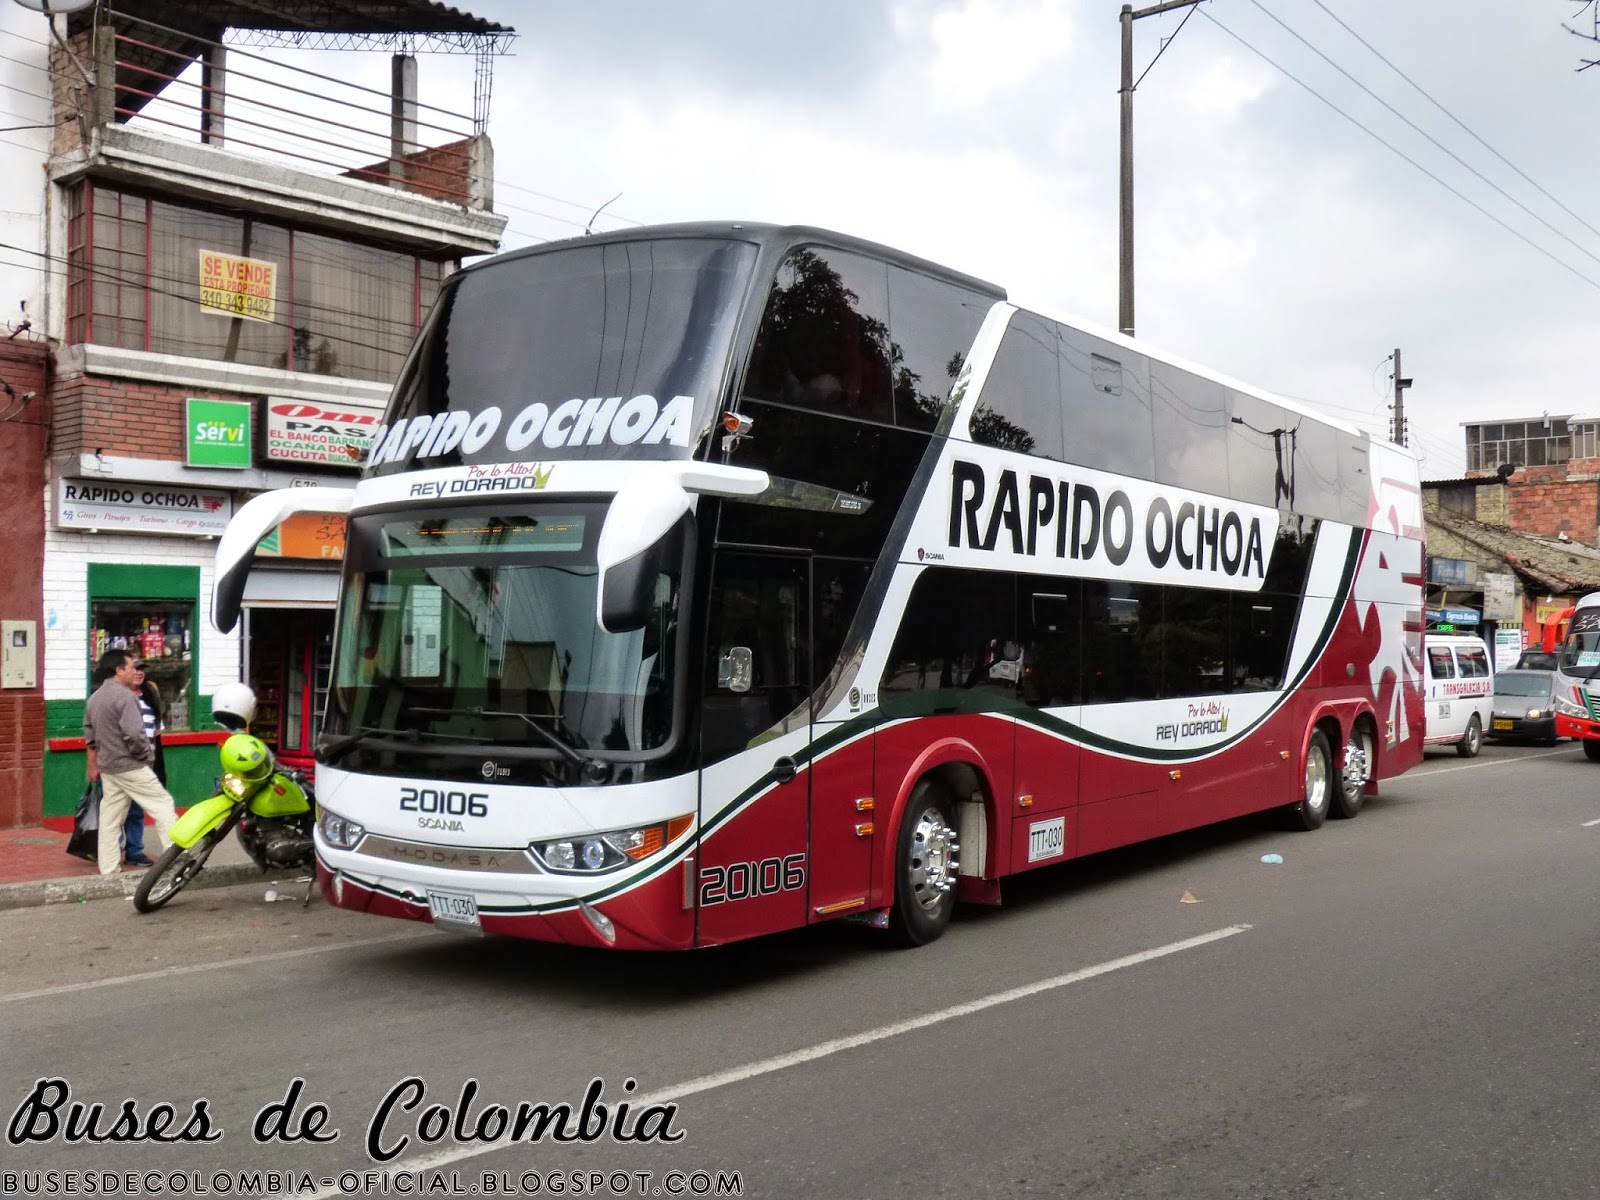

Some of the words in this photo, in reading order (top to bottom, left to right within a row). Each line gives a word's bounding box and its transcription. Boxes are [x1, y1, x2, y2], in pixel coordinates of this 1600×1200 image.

[204, 256, 222, 276] SE
[226, 260, 272, 285] VENDE
[203, 276, 224, 289] ESTA
[226, 280, 270, 298] PROPIEDAD
[195, 423, 245, 442] Servi
[286, 421, 377, 439] PAS
[505, 395, 694, 452] OCHOA
[270, 429, 284, 439] EL
[287, 431, 327, 444] BANCO
[270, 448, 327, 461] CUCUTA
[468, 465, 487, 478] Por
[490, 463, 501, 477] lo
[503, 462, 536, 475] Alto!
[65, 485, 134, 505] RAPIDO
[141, 491, 199, 508] OCHOA
[410, 481, 448, 497] REY
[450, 477, 536, 493] DORADO
[77, 511, 97, 520] Giros
[103, 512, 131, 523] Pasajes
[139, 515, 168, 524] Turismo
[175, 517, 197, 528] Carga
[948, 459, 1134, 566] RAPIDO
[1145, 496, 1264, 579] OCHOA
[925, 552, 945, 560] SCANIA
[1188, 704, 1199, 718] Por
[1156, 724, 1179, 742] REY
[1181, 719, 1223, 737] DORADO
[400, 787, 489, 818] 20106
[418, 817, 465, 832] SCANIA
[394, 847, 500, 867] MODASA
[700, 853, 805, 907] 20106
